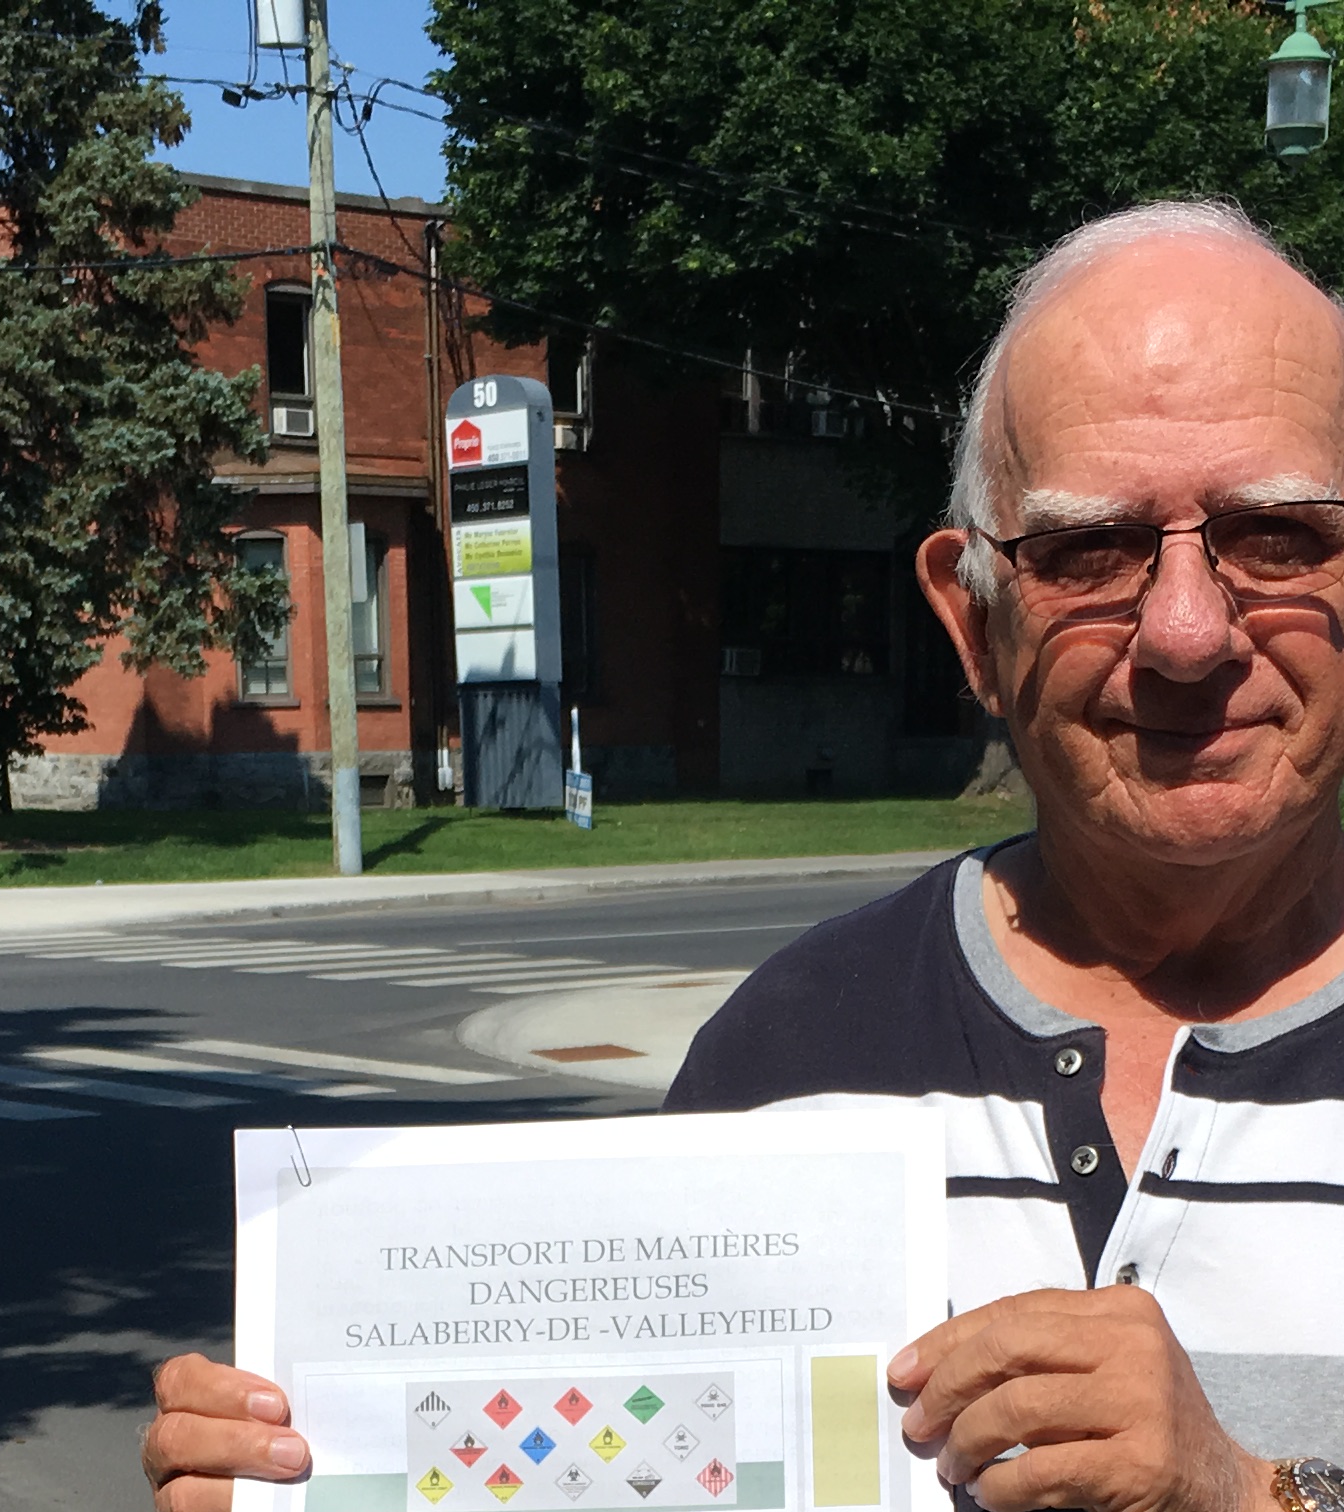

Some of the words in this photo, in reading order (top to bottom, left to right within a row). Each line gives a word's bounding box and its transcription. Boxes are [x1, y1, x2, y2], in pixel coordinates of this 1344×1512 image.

[473, 381, 497, 408] 50
[379, 1239, 573, 1271] TRANSPORT
[582, 1238, 626, 1263] DE
[634, 1228, 799, 1261] MATIÈRES
[469, 1273, 709, 1305] DANGEREUSES
[345, 1316, 590, 1348] SALABERRY-DE
[599, 1307, 833, 1340] -VALLEYFIELD
